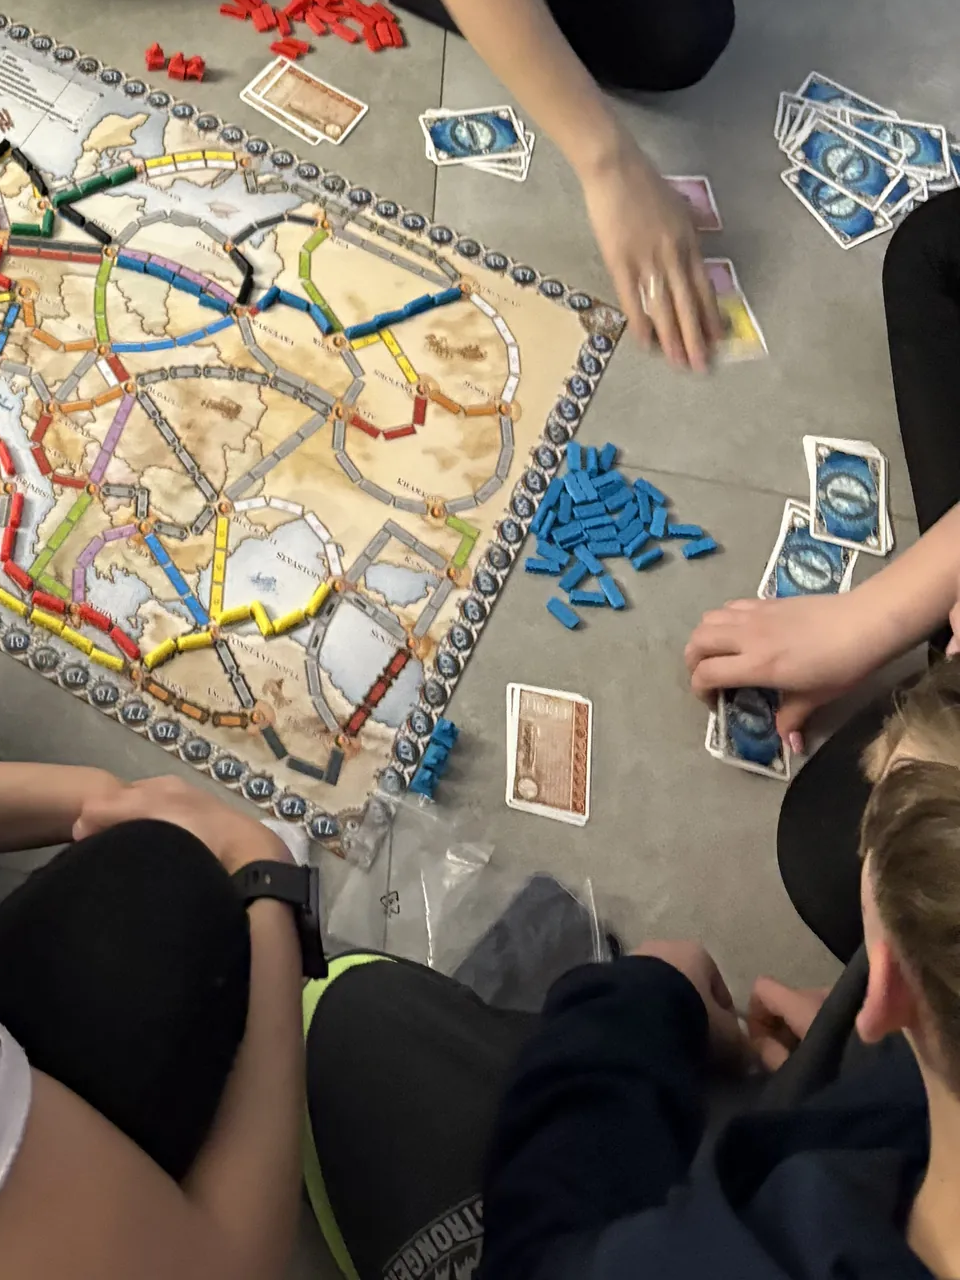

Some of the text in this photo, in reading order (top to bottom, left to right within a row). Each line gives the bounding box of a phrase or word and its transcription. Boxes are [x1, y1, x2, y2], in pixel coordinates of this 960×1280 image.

[13, 27, 26, 36] 27
[251, 142, 264, 152] 37
[276, 154, 290, 164] 38
[302, 166, 316, 176] 39
[92, 218, 118, 235] BERLIN
[545, 284, 560, 294] 48
[466, 600, 481, 619] 62
[9, 635, 26, 648] 81
[452, 628, 468, 647] 63
[65, 670, 85, 685] 79
[96, 687, 114, 702] 78
[126, 707, 146, 720] 77
[155, 724, 176, 739] 76
[398, 741, 415, 761] 67
[219, 759, 238, 776] 74
[250, 780, 270, 795] 73
[282, 801, 302, 814] 72
[317, 820, 333, 835] 71
